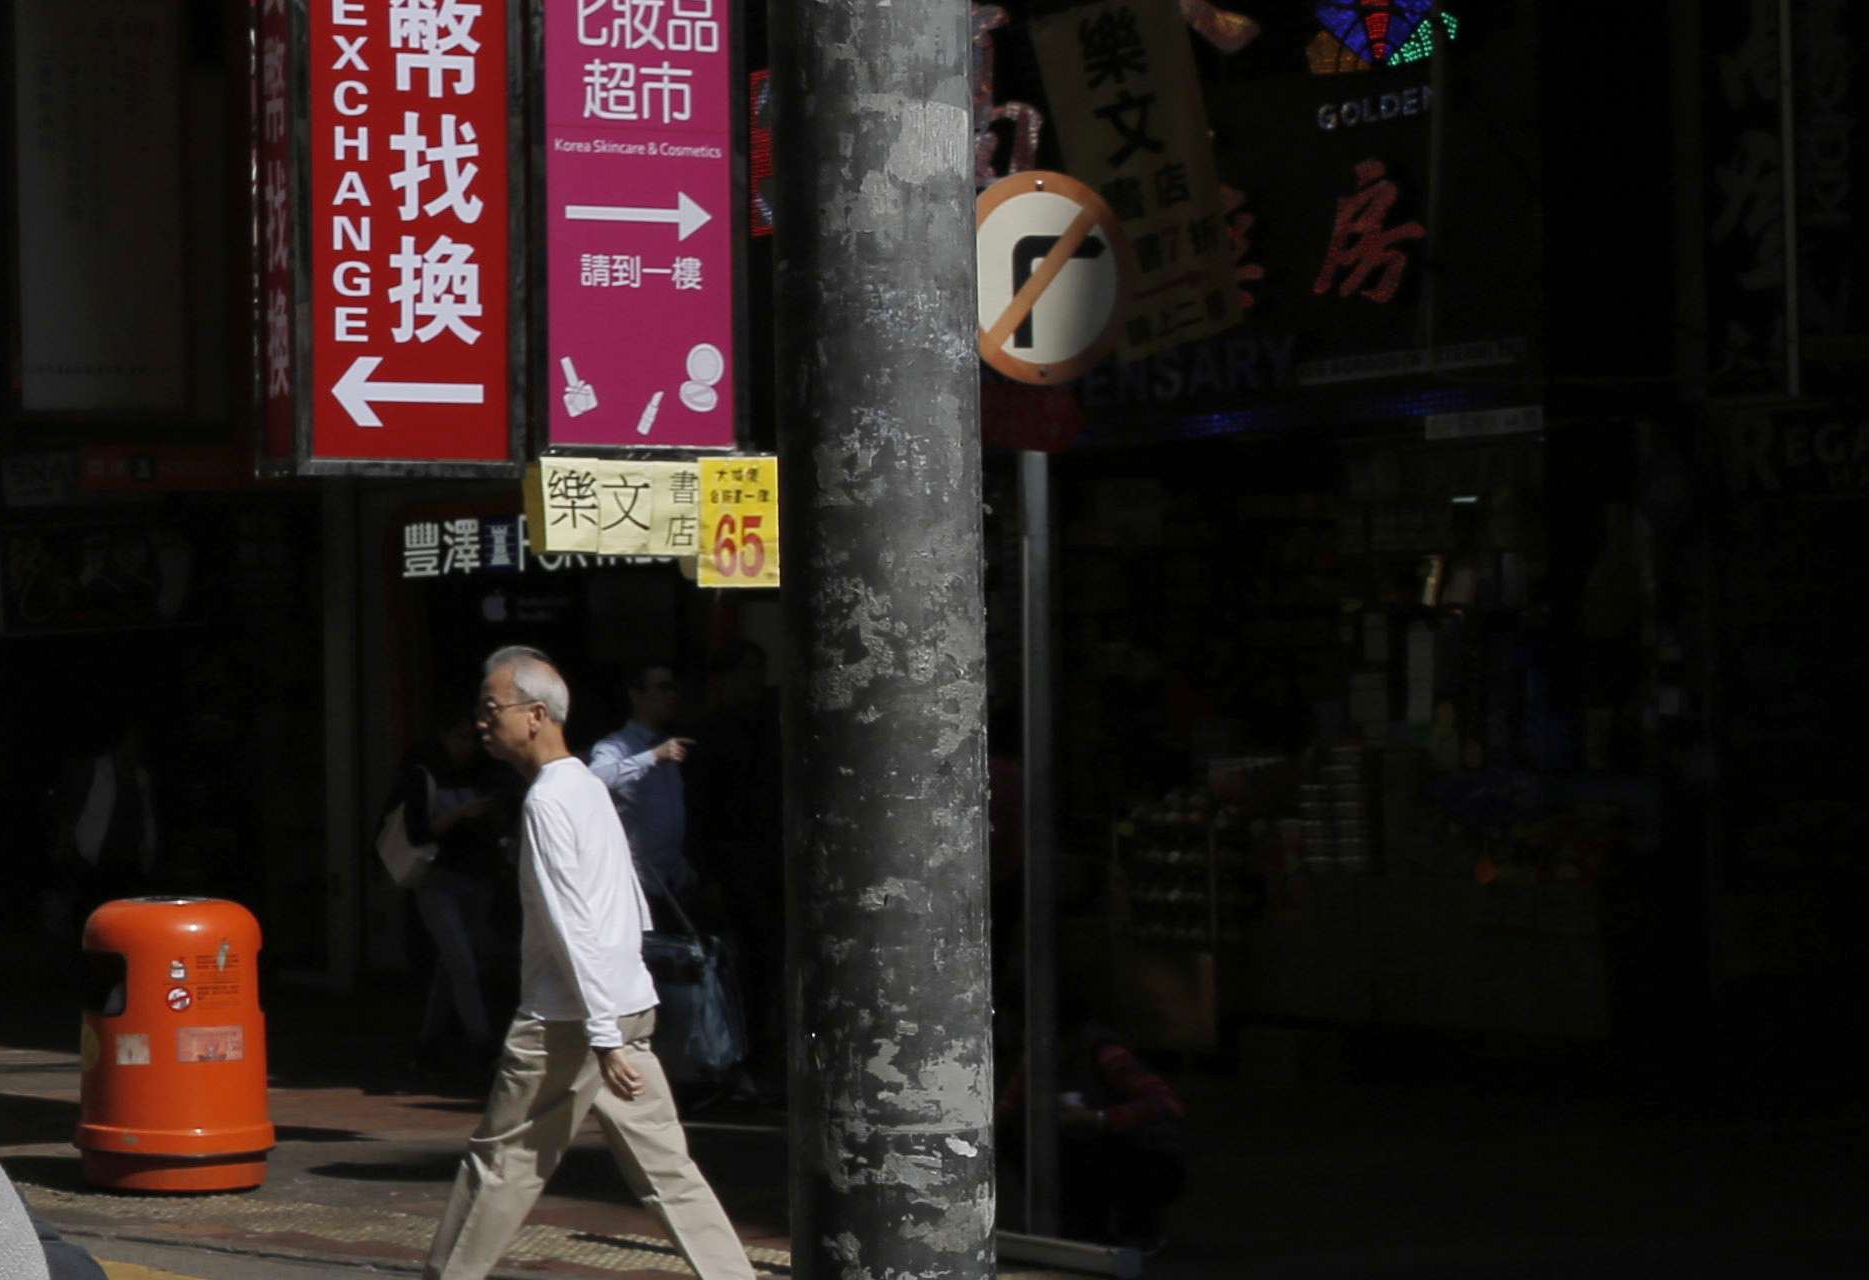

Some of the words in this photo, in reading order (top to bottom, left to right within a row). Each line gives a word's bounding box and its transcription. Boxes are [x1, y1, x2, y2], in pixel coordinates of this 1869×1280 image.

[583, 58, 694, 124] 超市
[554, 138, 591, 155] Korea
[593, 139, 646, 156] Skincare
[647, 141, 658, 156] &
[659, 142, 722, 159] Cosmetics
[580, 253, 703, 291] 請到一樓
[548, 469, 650, 531] 樂文
[402, 517, 481, 579] 豐澤
[714, 514, 765, 578] 65
